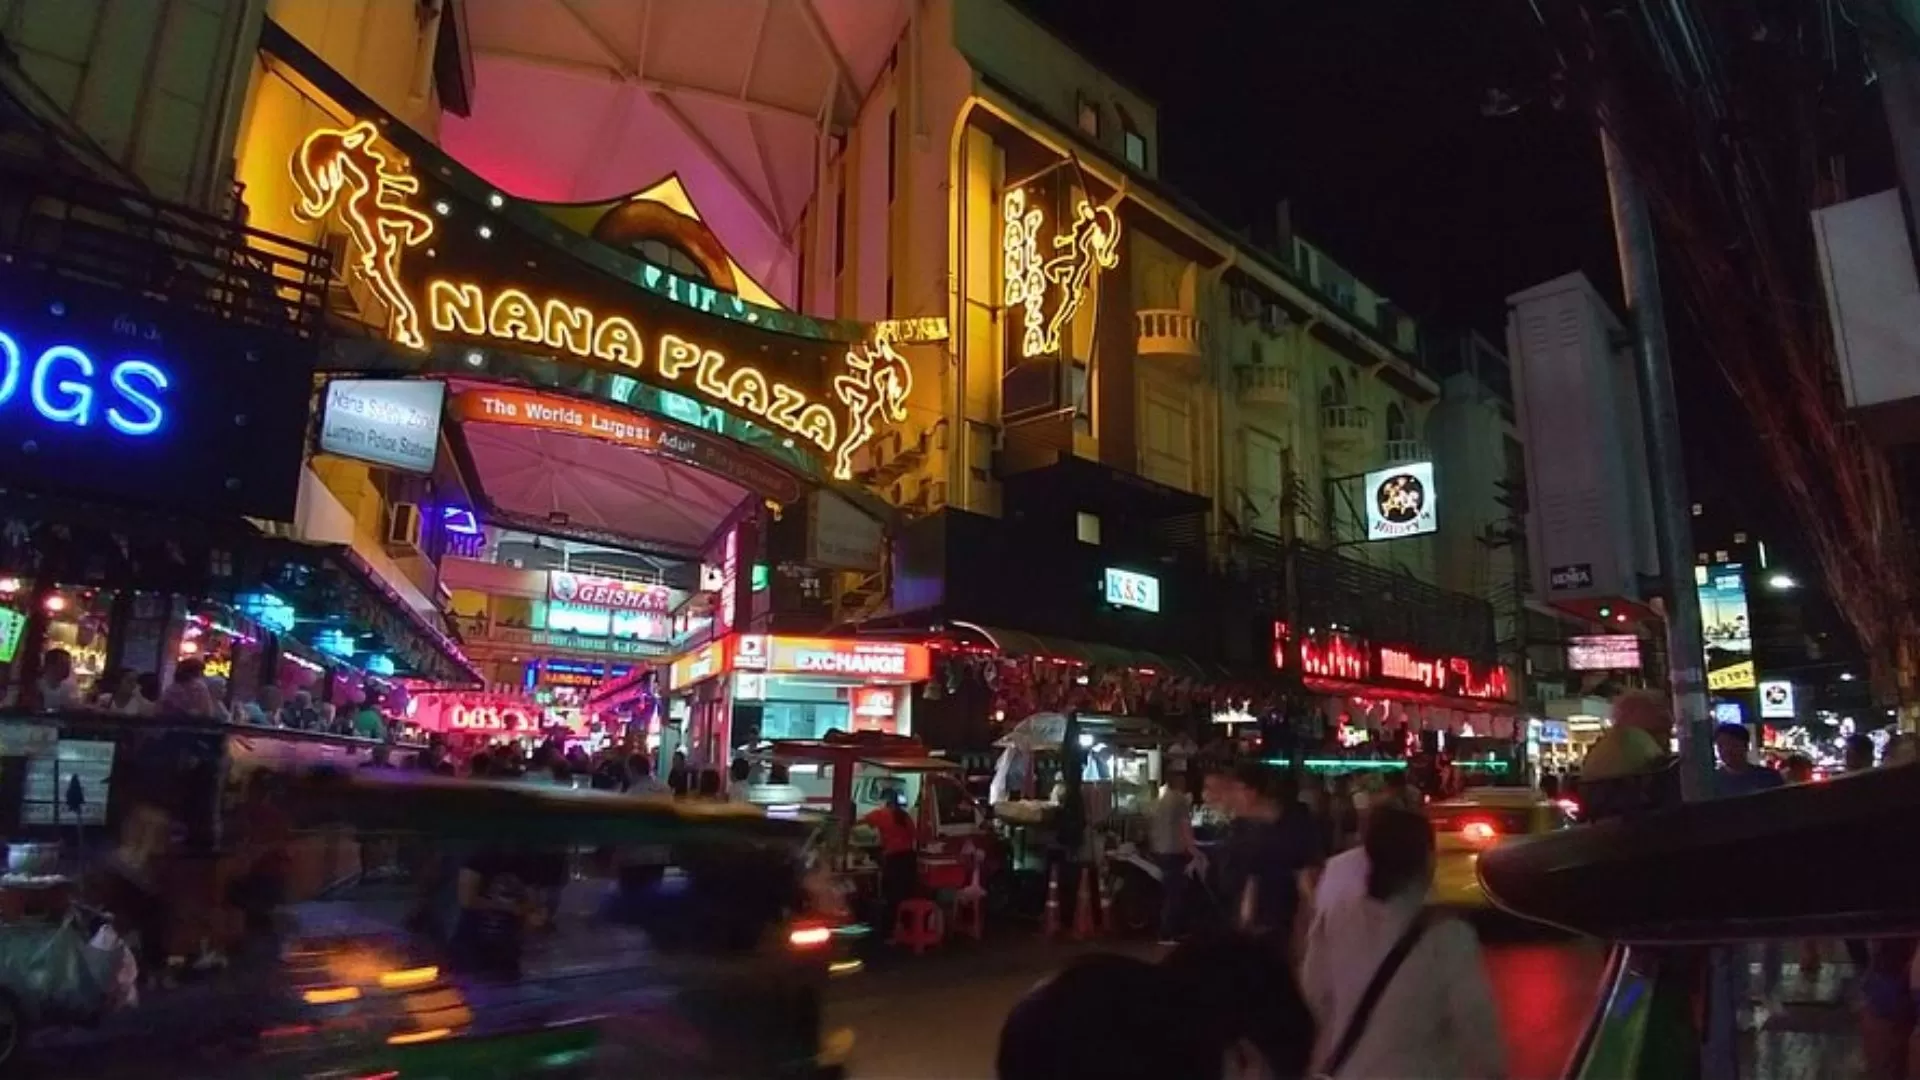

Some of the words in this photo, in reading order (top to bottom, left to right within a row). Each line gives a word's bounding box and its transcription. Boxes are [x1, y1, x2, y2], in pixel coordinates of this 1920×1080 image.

[1004, 188, 1025, 307] NANA
[1023, 209, 1047, 358] PLAZA
[431, 280, 644, 368] NANA
[659, 334, 837, 452] PLAZA
[482, 398, 517, 416] The
[525, 403, 584, 426] Worlds
[592, 413, 651, 442] Largest
[579, 586, 652, 609] GEISHA
[1109, 574, 1147, 603] K&S
[794, 651, 905, 674] EXCHANGE
